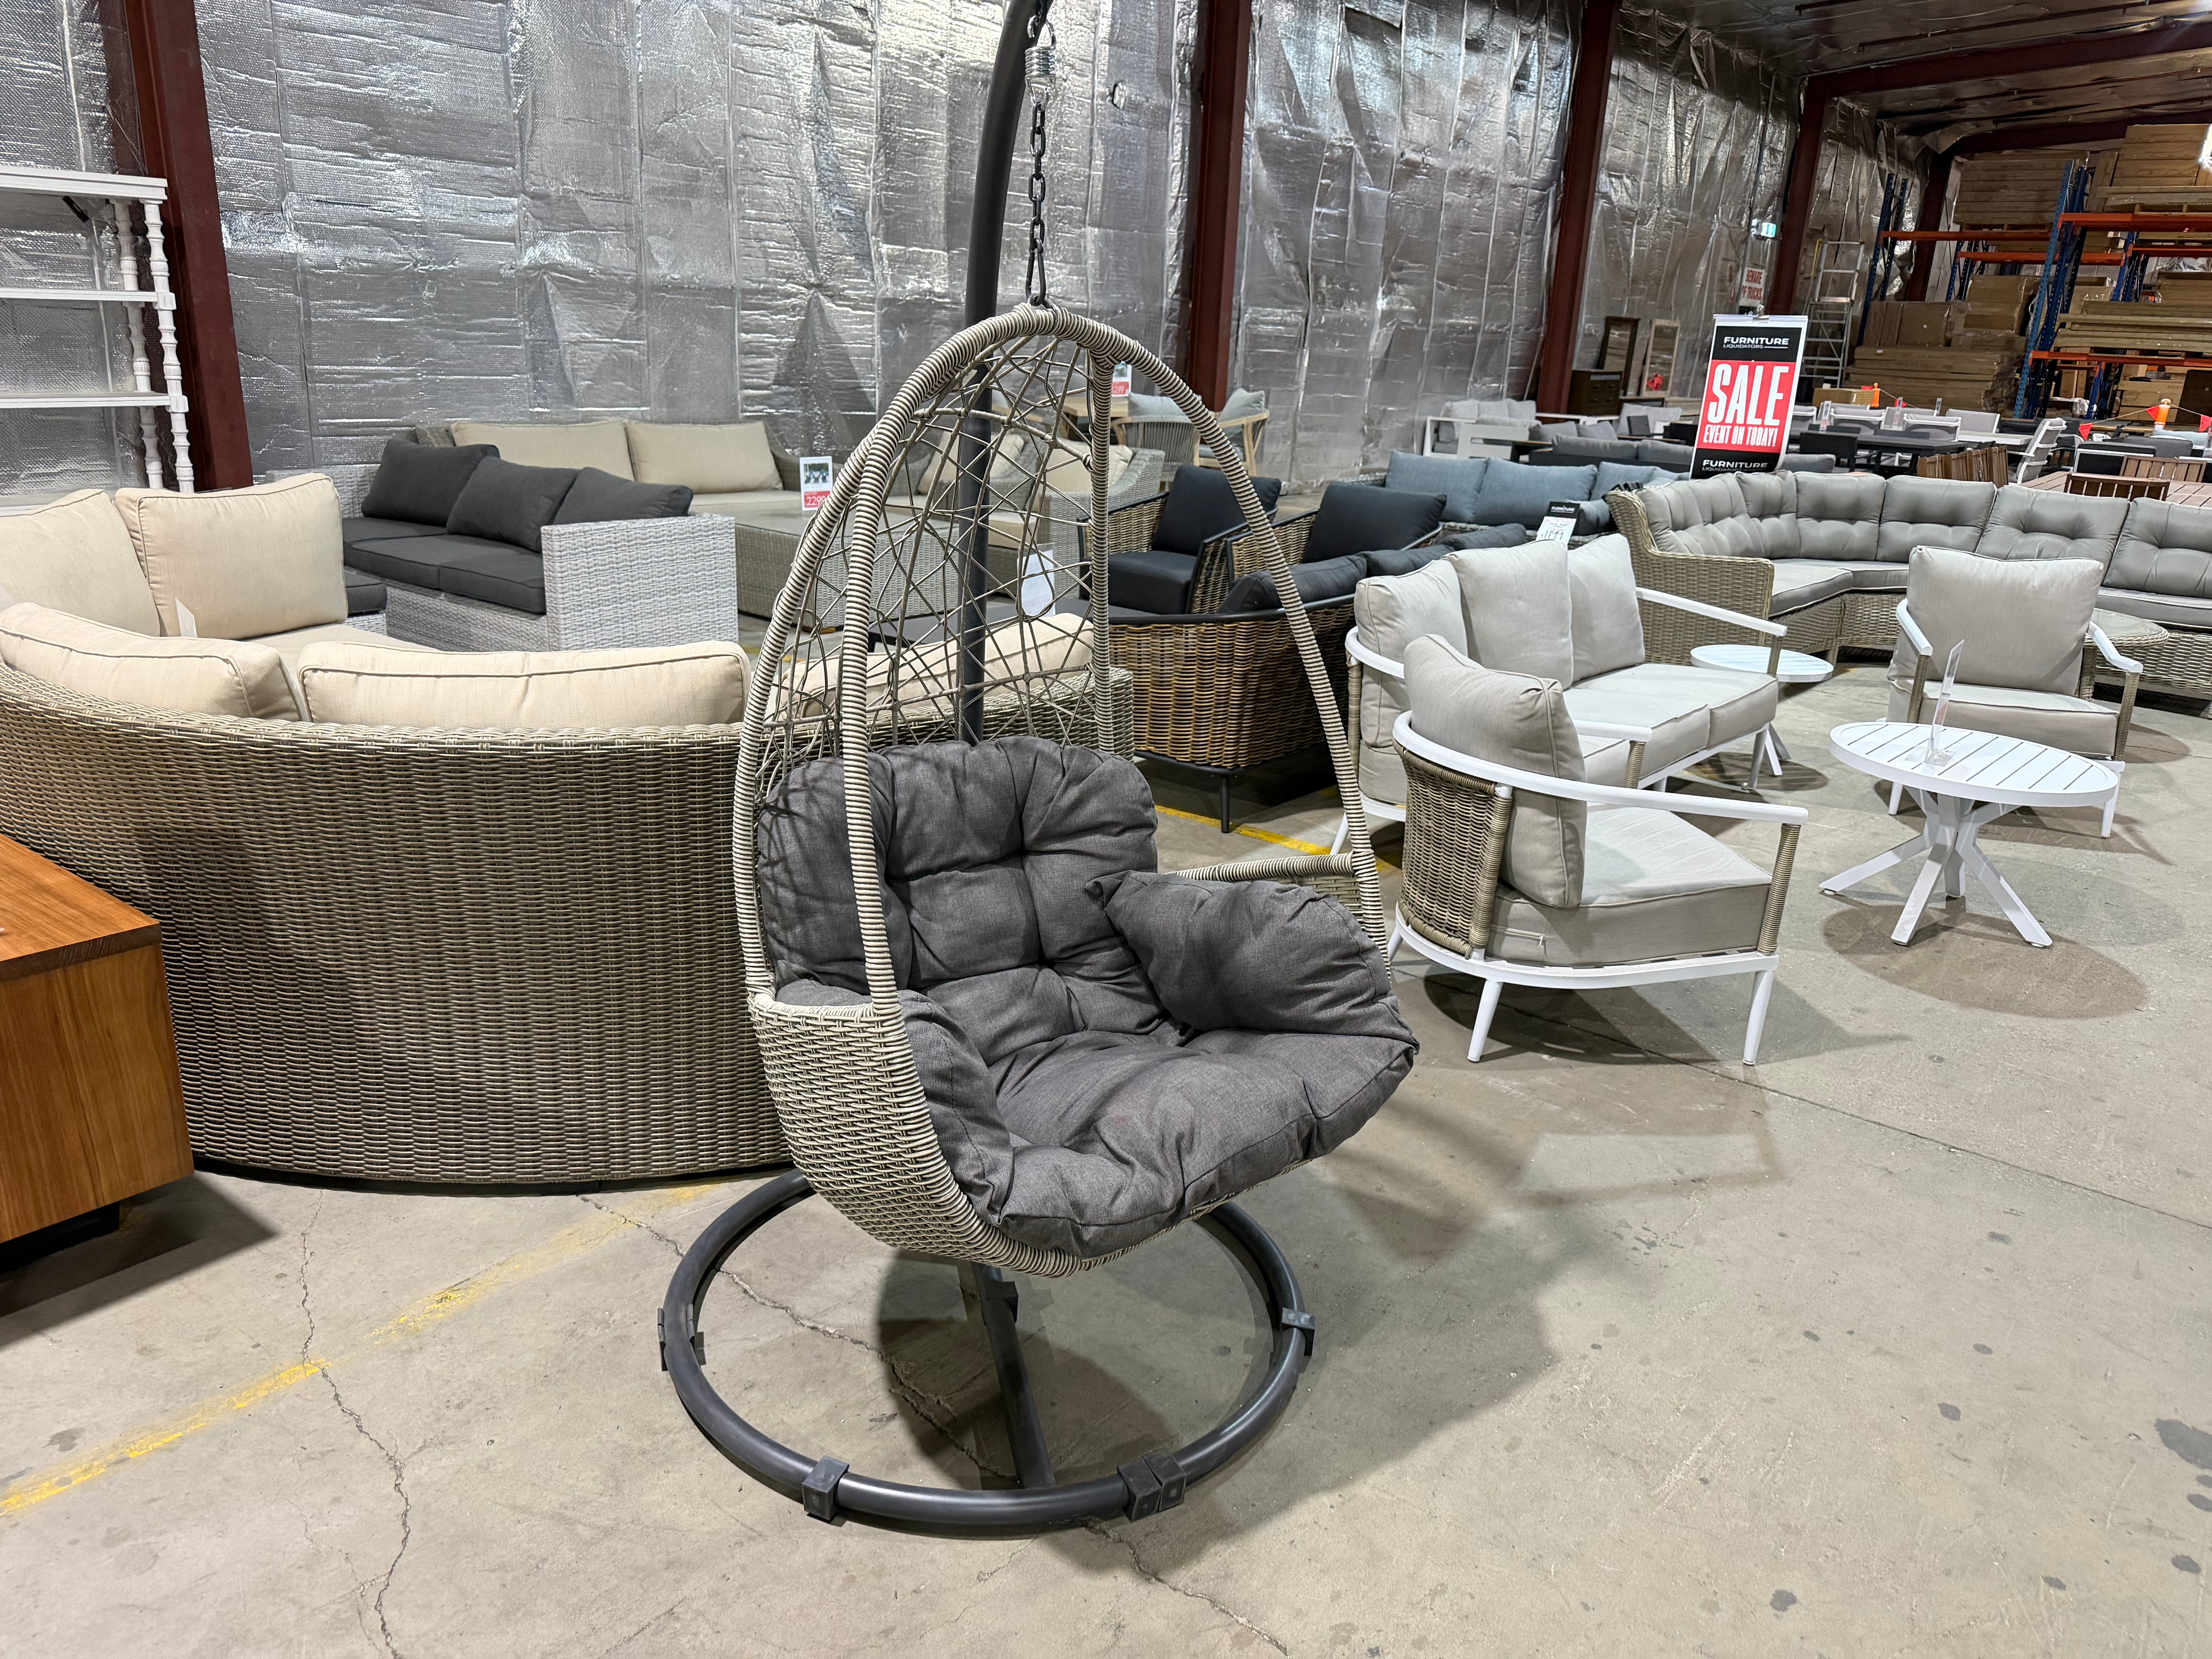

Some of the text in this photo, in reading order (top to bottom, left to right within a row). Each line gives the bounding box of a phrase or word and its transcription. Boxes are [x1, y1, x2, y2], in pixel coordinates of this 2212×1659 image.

[1746, 269, 1763, 284] BEWARE
[1724, 337, 1790, 345] FURNITURE
[1707, 364, 1789, 426] SALE
[1703, 424, 1778, 447] EVENT ON TODAY!
[1703, 460, 1768, 468] FURNITURE
